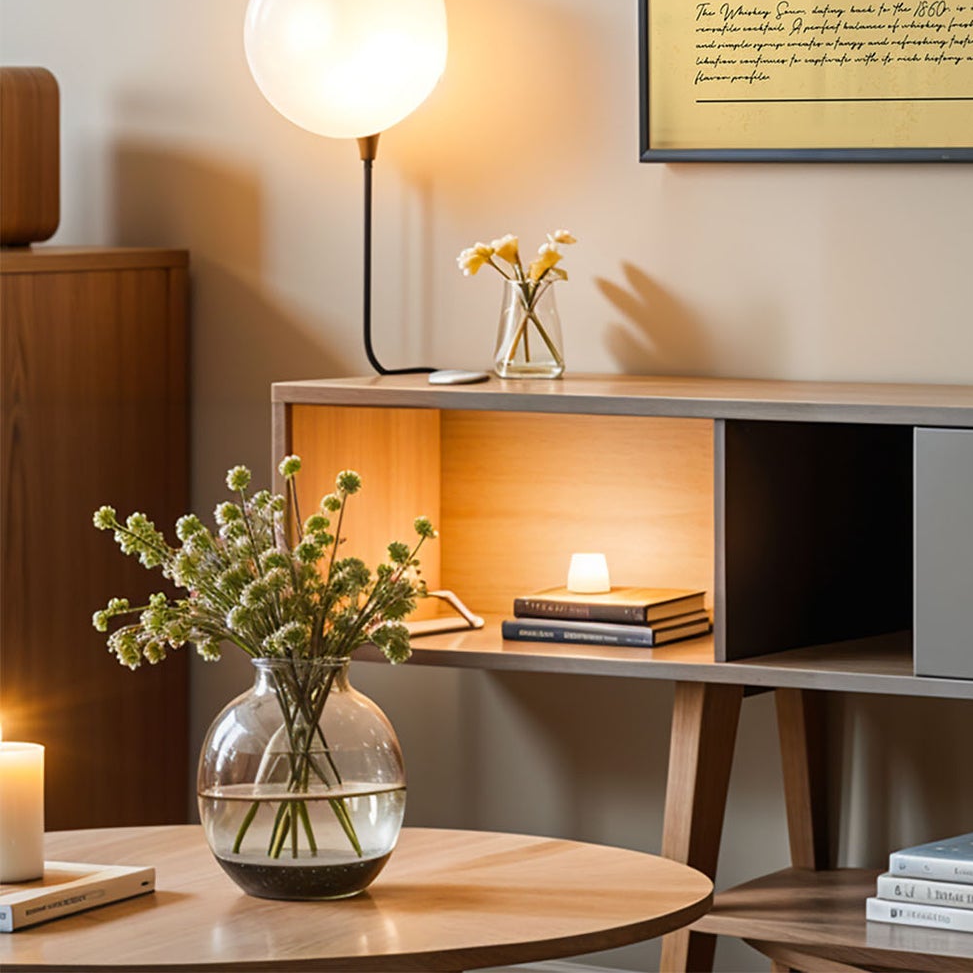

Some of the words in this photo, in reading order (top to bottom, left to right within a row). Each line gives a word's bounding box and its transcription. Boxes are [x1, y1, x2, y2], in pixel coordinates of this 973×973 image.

[695, 2, 716, 21] The
[719, 2, 773, 21] Whiskey
[811, 3, 846, 18] dating
[850, 5, 876, 14] back
[877, 2, 891, 17] to
[892, 2, 912, 17] the
[956, 4, 966, 12] is
[695, 21, 741, 36] versatile
[788, 17, 803, 37] A
[803, 19, 841, 35] perfect
[843, 21, 886, 31] balance
[887, 18, 900, 33] of
[695, 40, 717, 49] and
[717, 40, 752, 51] simple
[752, 42, 785, 52] syrup
[787, 36, 825, 51] creates
[833, 35, 866, 50] tangy
[867, 37, 890, 47] and
[890, 34, 949, 50] refreshing
[739, 53, 788, 68] continues
[788, 53, 802, 68] to
[804, 53, 852, 67] captivate
[854, 51, 879, 66] with
[880, 52, 894, 66] its
[896, 53, 922, 63] rich
[924, 50, 964, 66] history
[694, 70, 731, 85] flavor
